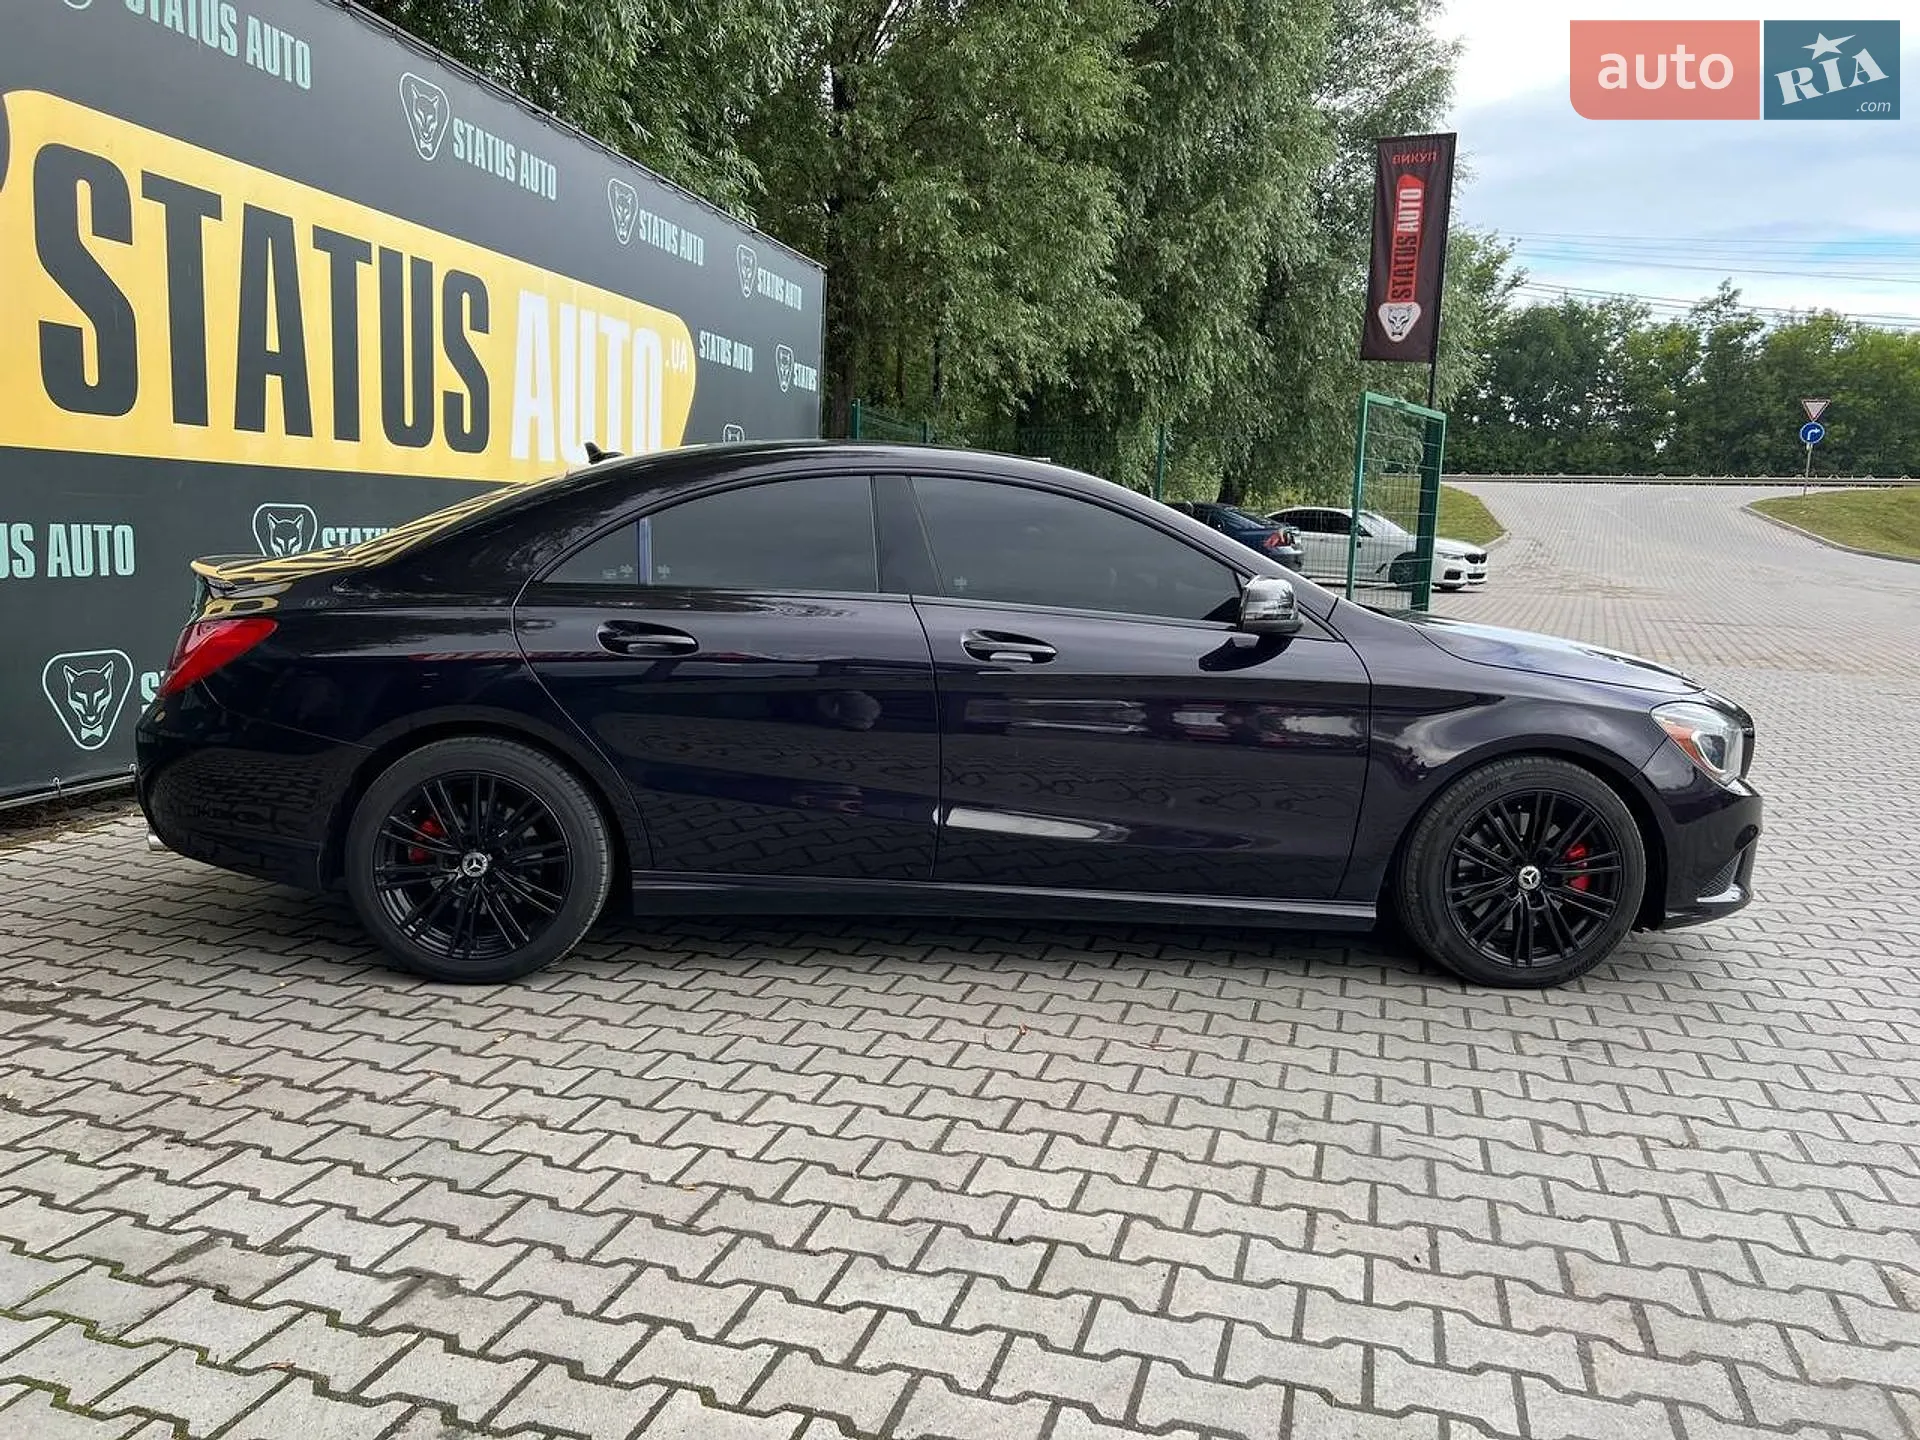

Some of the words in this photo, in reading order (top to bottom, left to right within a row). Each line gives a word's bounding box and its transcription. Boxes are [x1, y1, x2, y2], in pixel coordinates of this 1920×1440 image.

[246, 15, 311, 89] AUTO
[453, 117, 516, 182] STATUS
[520, 149, 557, 201] AUTO
[639, 209, 679, 256] STATUS
[679, 228, 704, 266] AUTO
[1396, 188, 1422, 232] AUTO
[1391, 235, 1417, 299] STATUS
[33, 143, 490, 454] STATUS
[511, 289, 662, 465] AUTO
[699, 329, 732, 367] STATUS
[732, 341, 753, 373] AUTO
[47, 523, 135, 577] AUTO
